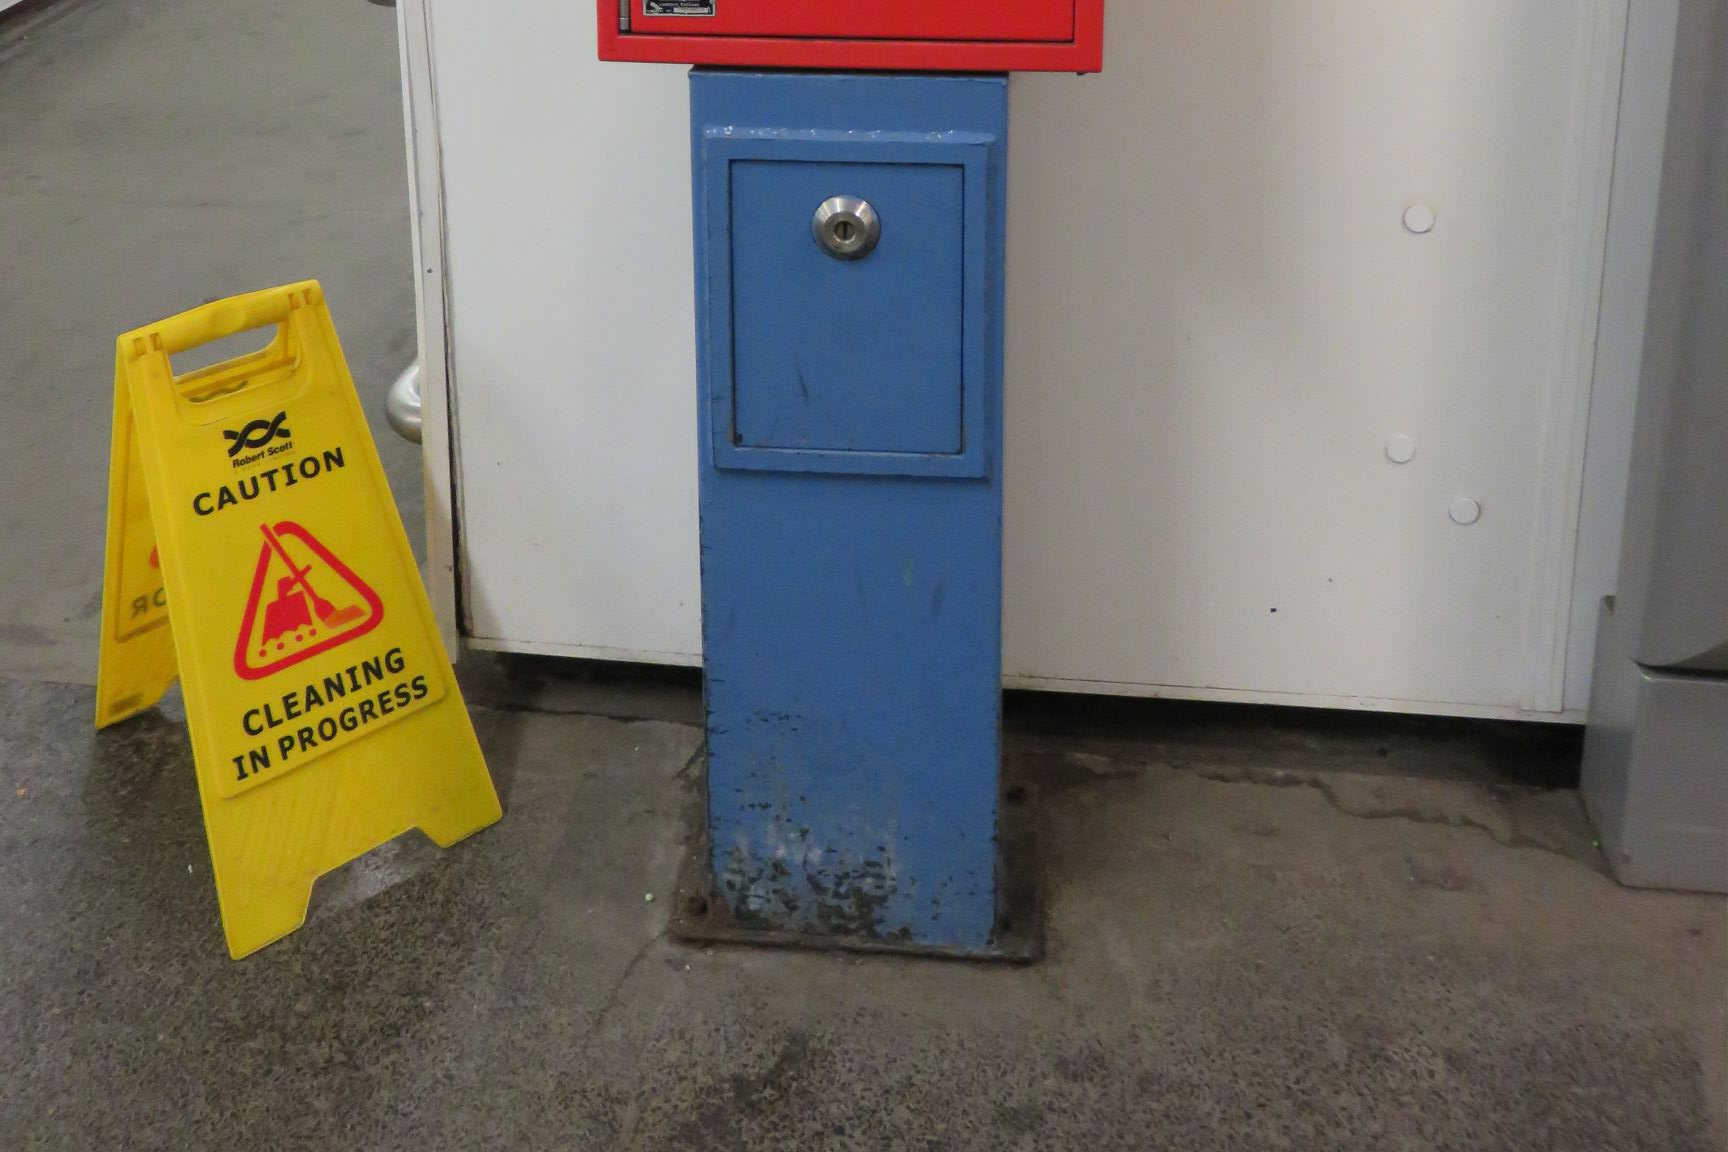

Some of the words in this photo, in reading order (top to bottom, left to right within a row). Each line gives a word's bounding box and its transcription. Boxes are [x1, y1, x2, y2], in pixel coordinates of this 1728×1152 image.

[192, 447, 346, 517] CAUTION
[232, 450, 265, 469] Robert
[267, 441, 294, 456] Scott
[232, 745, 270, 781] IN
[278, 675, 429, 761] PROGRESS
[243, 647, 405, 736] CLEANING
